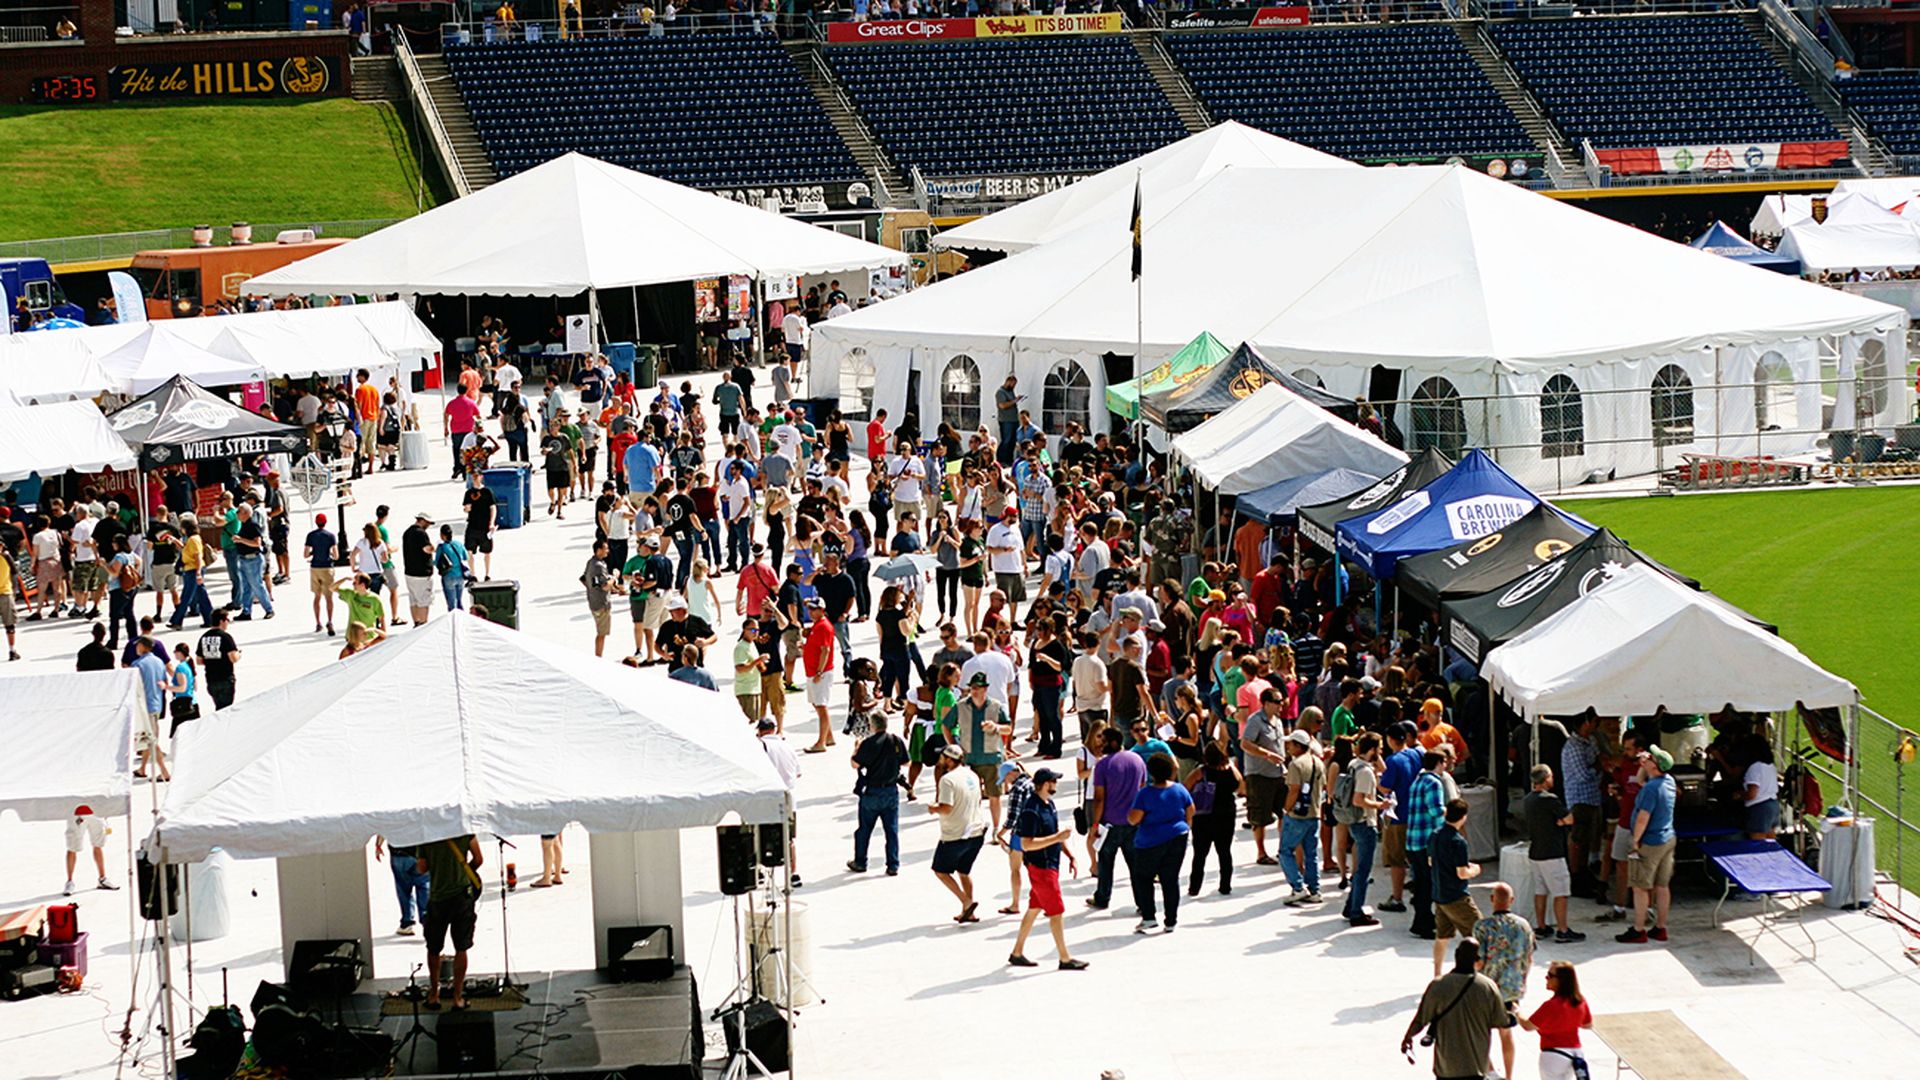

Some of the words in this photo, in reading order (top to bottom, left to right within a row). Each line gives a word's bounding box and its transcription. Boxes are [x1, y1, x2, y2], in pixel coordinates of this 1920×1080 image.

[858, 22, 904, 37] Great
[906, 20, 943, 38] Clips
[1035, 18, 1055, 31] IT'S
[1058, 17, 1073, 30] BO
[1076, 15, 1107, 30] TIME!
[1171, 18, 1215, 28] Safelite
[1258, 17, 1302, 25] safelite.com
[121, 68, 155, 95] Hit
[159, 67, 188, 91] the
[193, 61, 274, 94] HILLS
[43, 78, 96, 98] 12:35
[986, 178, 1022, 196] BEER
[1026, 177, 1039, 194] IS
[1044, 175, 1068, 192] MY
[182, 440, 226, 460] WHITE
[227, 436, 270, 456] STREET
[1457, 503, 1524, 520] CAROLINA
[1460, 518, 1514, 536] BREWE
